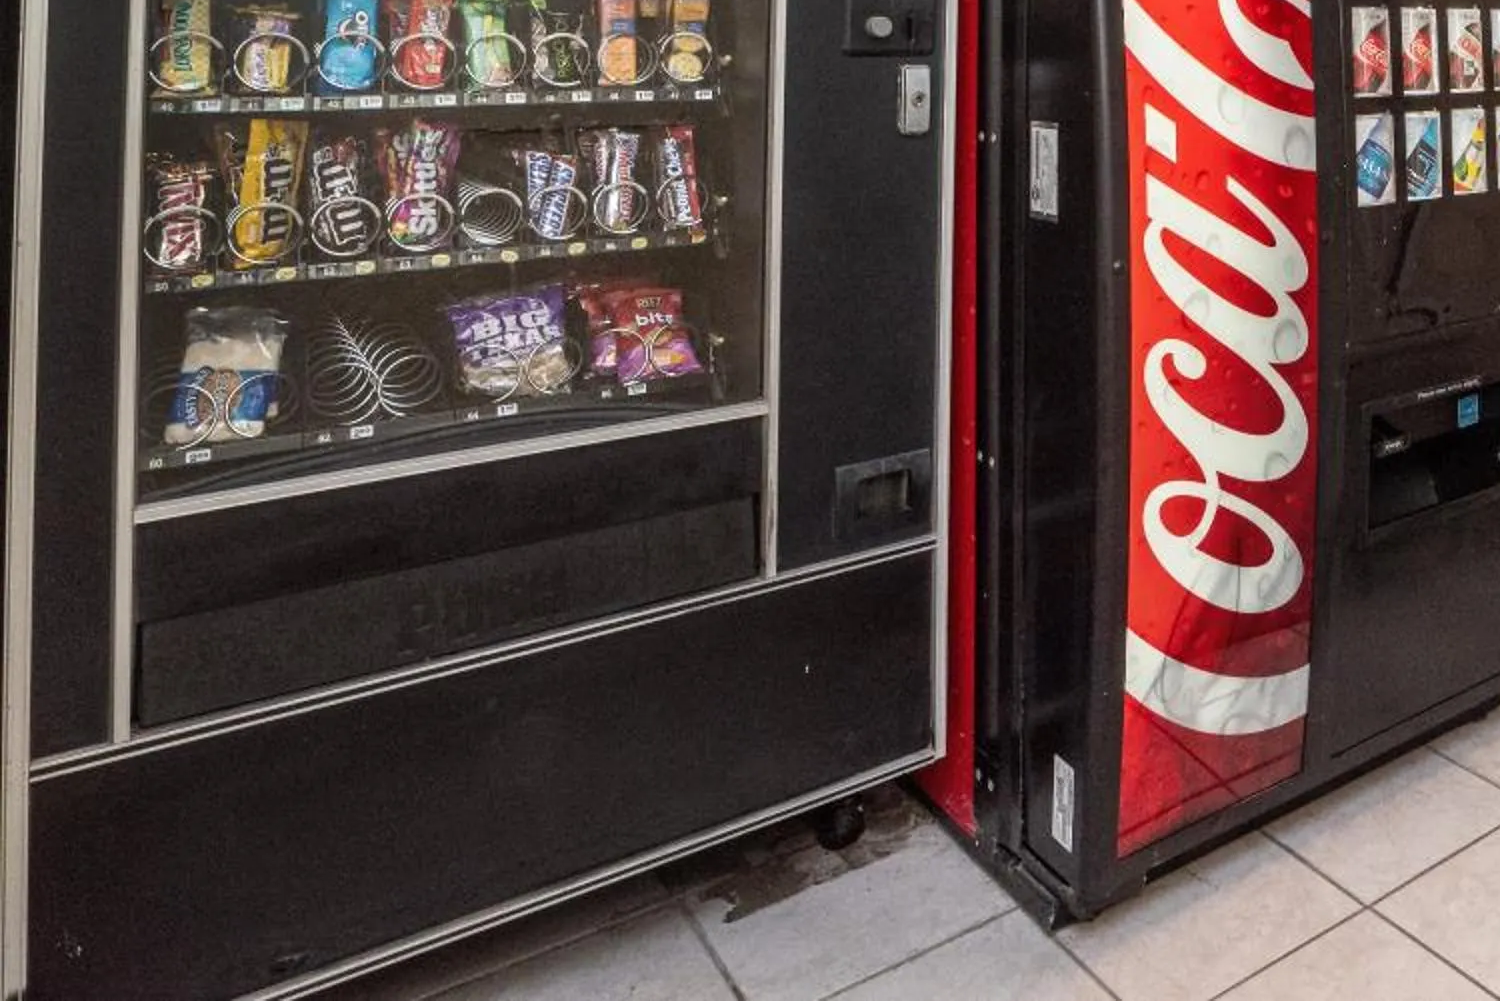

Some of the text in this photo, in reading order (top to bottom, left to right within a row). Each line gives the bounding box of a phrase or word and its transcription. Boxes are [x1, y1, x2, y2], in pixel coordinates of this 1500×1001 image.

[408, 129, 444, 236] Skittles
[466, 324, 562, 362] TEXAS
[471, 309, 550, 342] BIG
